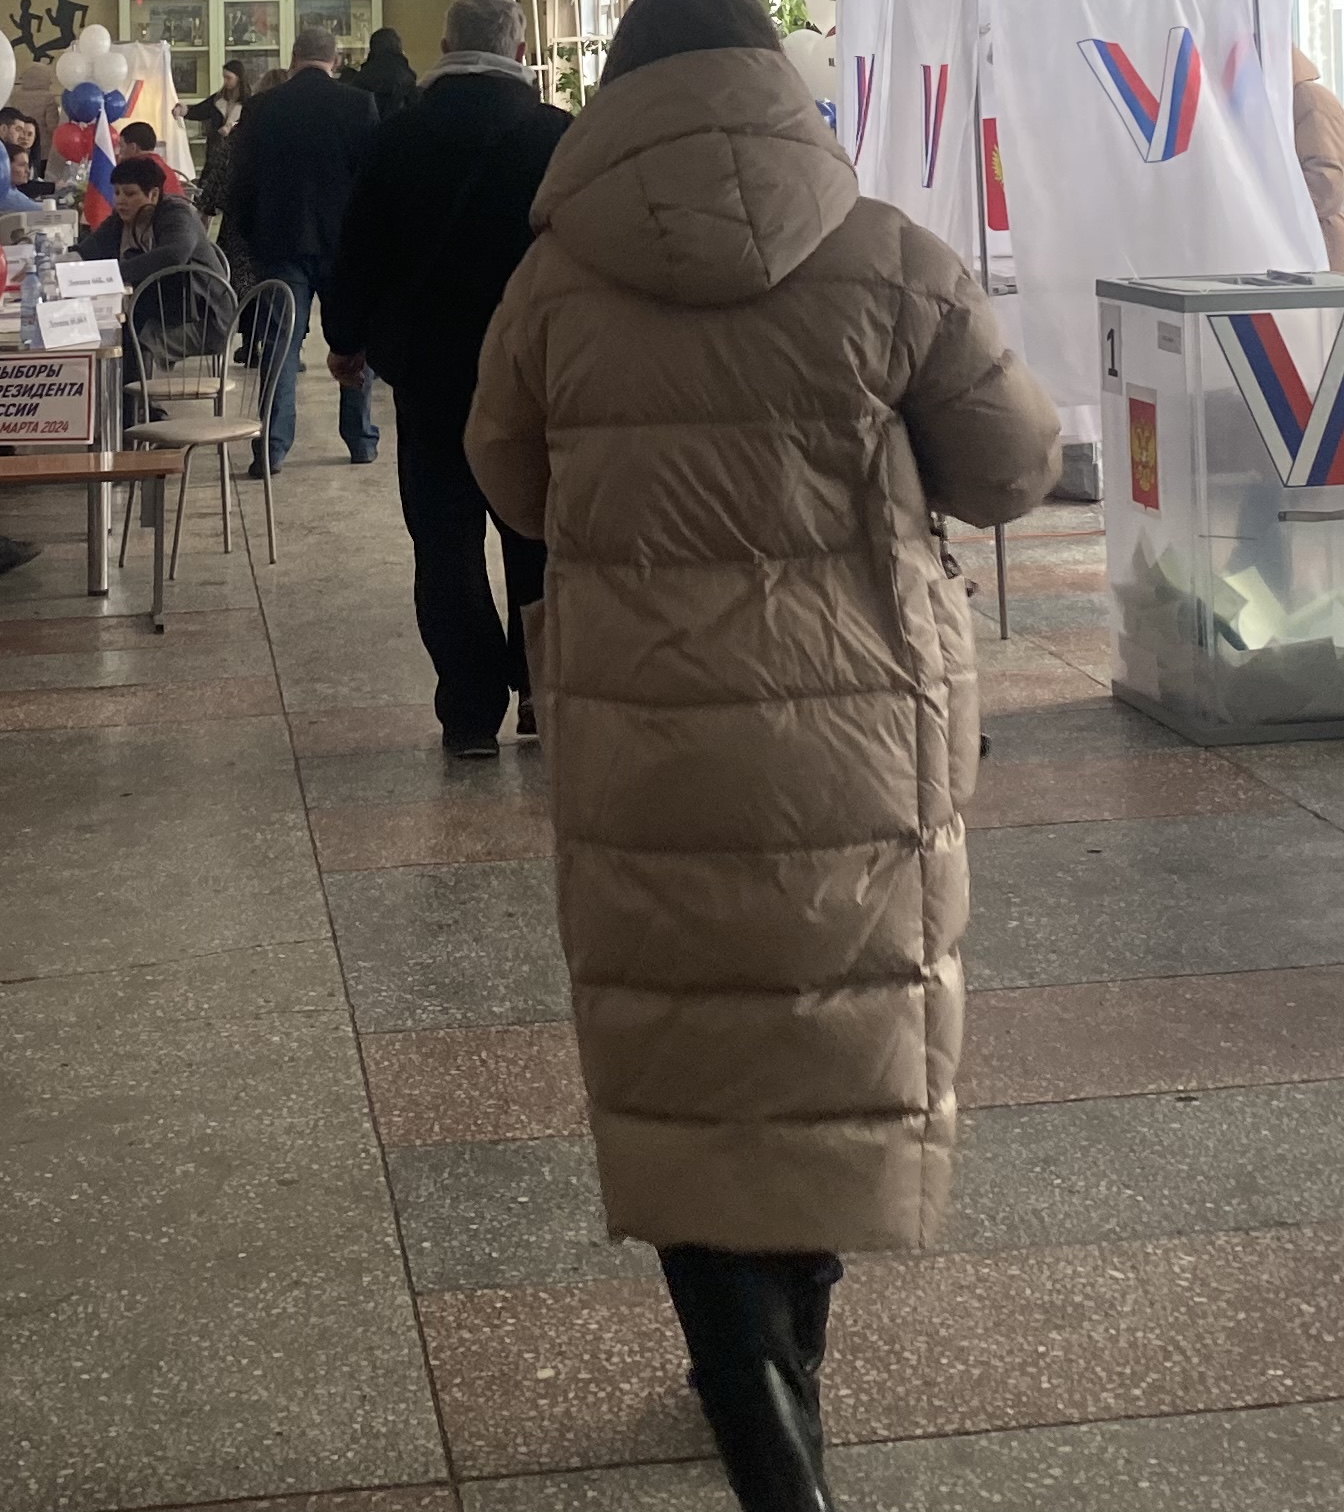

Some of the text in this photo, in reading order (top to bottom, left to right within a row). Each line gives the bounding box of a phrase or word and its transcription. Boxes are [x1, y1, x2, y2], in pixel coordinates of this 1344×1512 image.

[1106, 328, 1118, 378] 1
[0, 421, 41, 434] МАРТА
[41, 420, 69, 433] 2024
